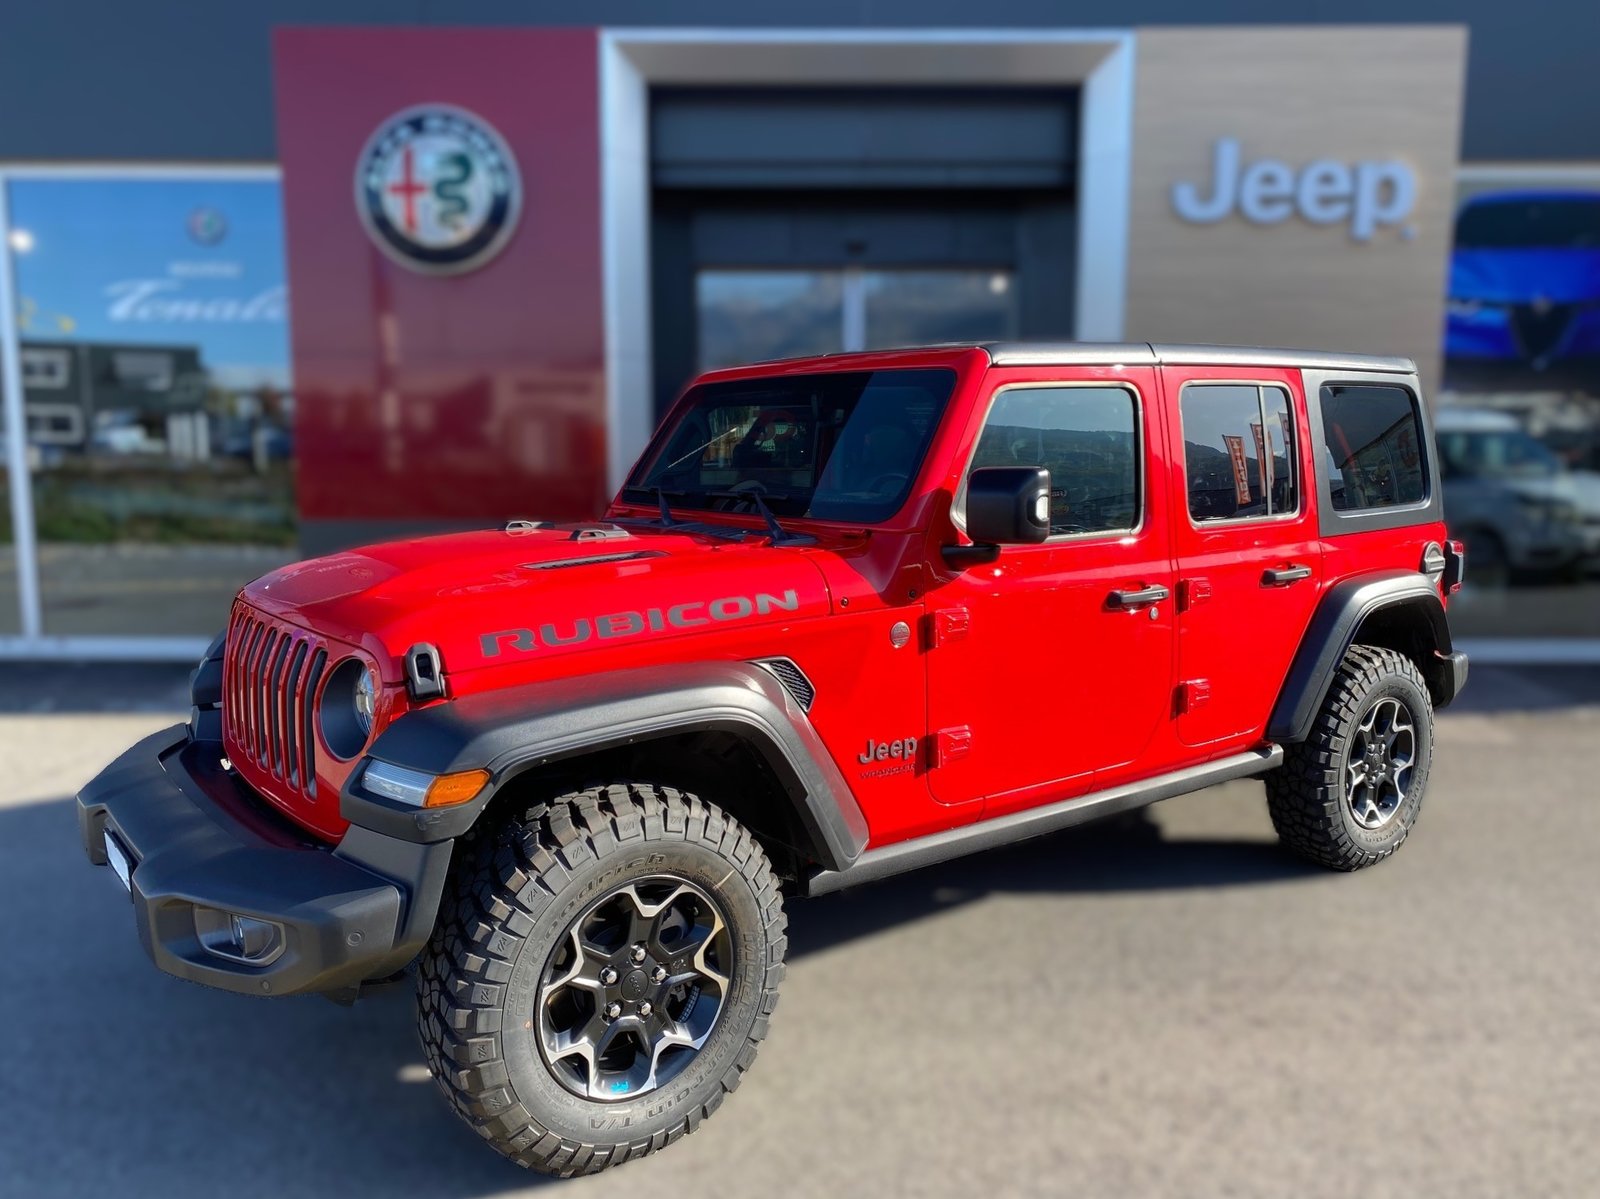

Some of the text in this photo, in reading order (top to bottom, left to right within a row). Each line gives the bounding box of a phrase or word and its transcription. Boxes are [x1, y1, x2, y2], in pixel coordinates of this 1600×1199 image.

[1170, 137, 1418, 240] Jeep
[479, 589, 799, 657] RUBICON
[859, 736, 918, 764] Jeep
